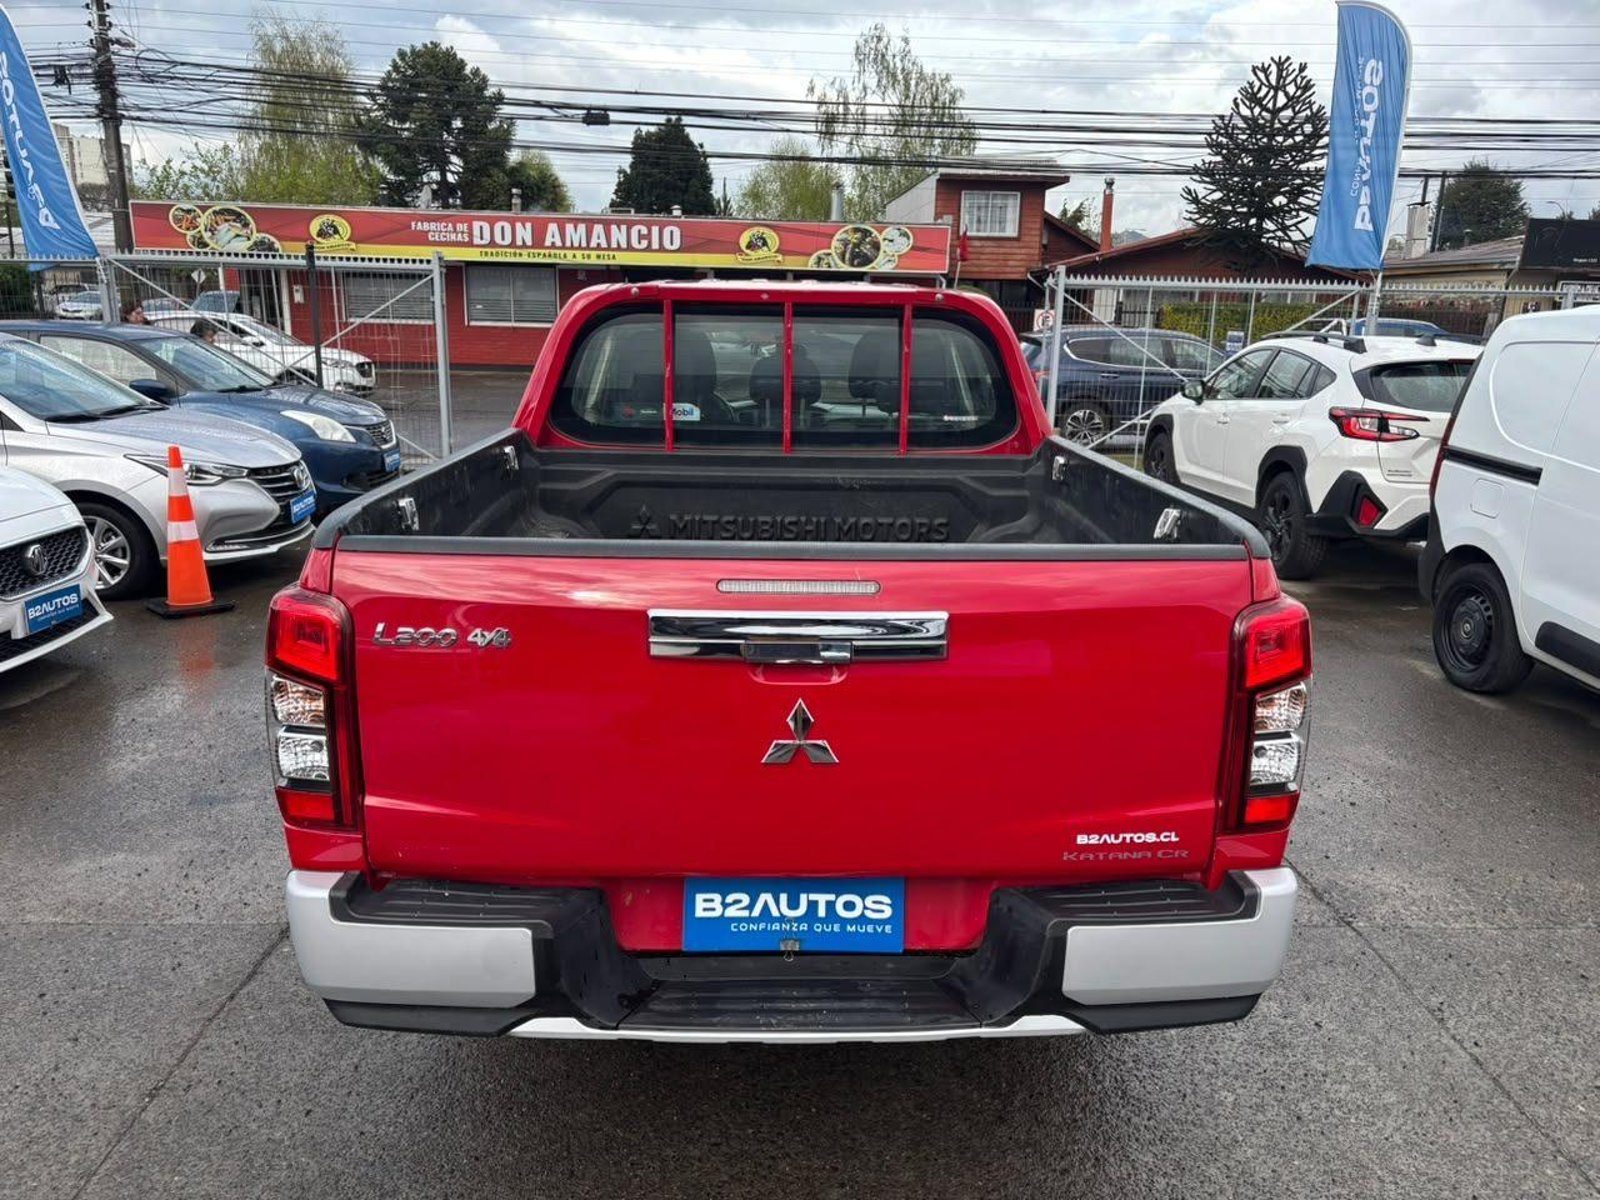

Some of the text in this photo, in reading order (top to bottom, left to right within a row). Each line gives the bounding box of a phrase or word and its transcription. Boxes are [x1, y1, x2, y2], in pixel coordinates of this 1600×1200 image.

[411, 221, 469, 232] FABRICA DE
[472, 220, 681, 250] DON AMANCIO
[428, 231, 470, 242] CECINAS
[669, 513, 949, 541] MITSUBISHI MOTORS
[28, 593, 79, 619] B2AUTOS
[373, 622, 458, 647] L200
[1076, 831, 1180, 845] B2AUTOS.CL
[1063, 849, 1189, 861] KATANA CR
[694, 892, 893, 919] B2AUTOS
[730, 922, 893, 934] CONFIANZA QUE MUEVE
